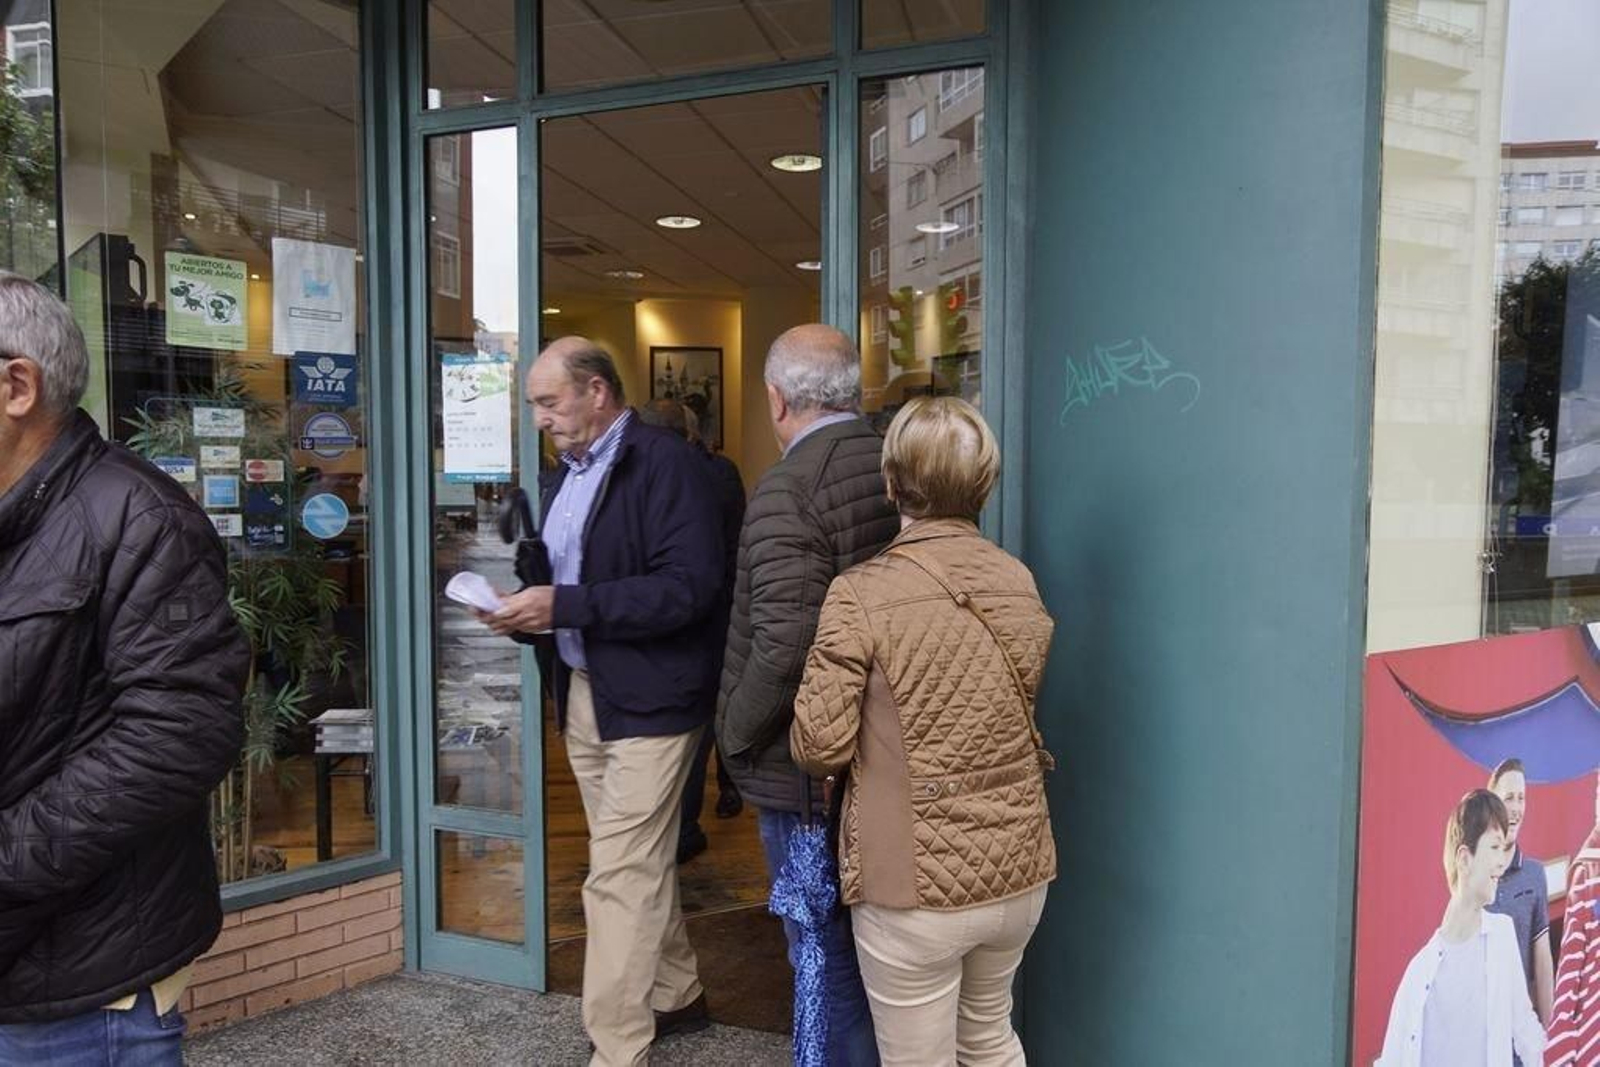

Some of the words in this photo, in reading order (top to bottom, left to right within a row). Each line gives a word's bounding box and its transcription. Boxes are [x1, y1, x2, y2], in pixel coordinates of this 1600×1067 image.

[181, 257, 225, 270] ABIERTOS
[225, 263, 233, 271] A
[169, 263, 181, 273] TU
[182, 265, 213, 276] MEJOR
[215, 269, 245, 280] AMIGO
[307, 378, 346, 392] IATA
